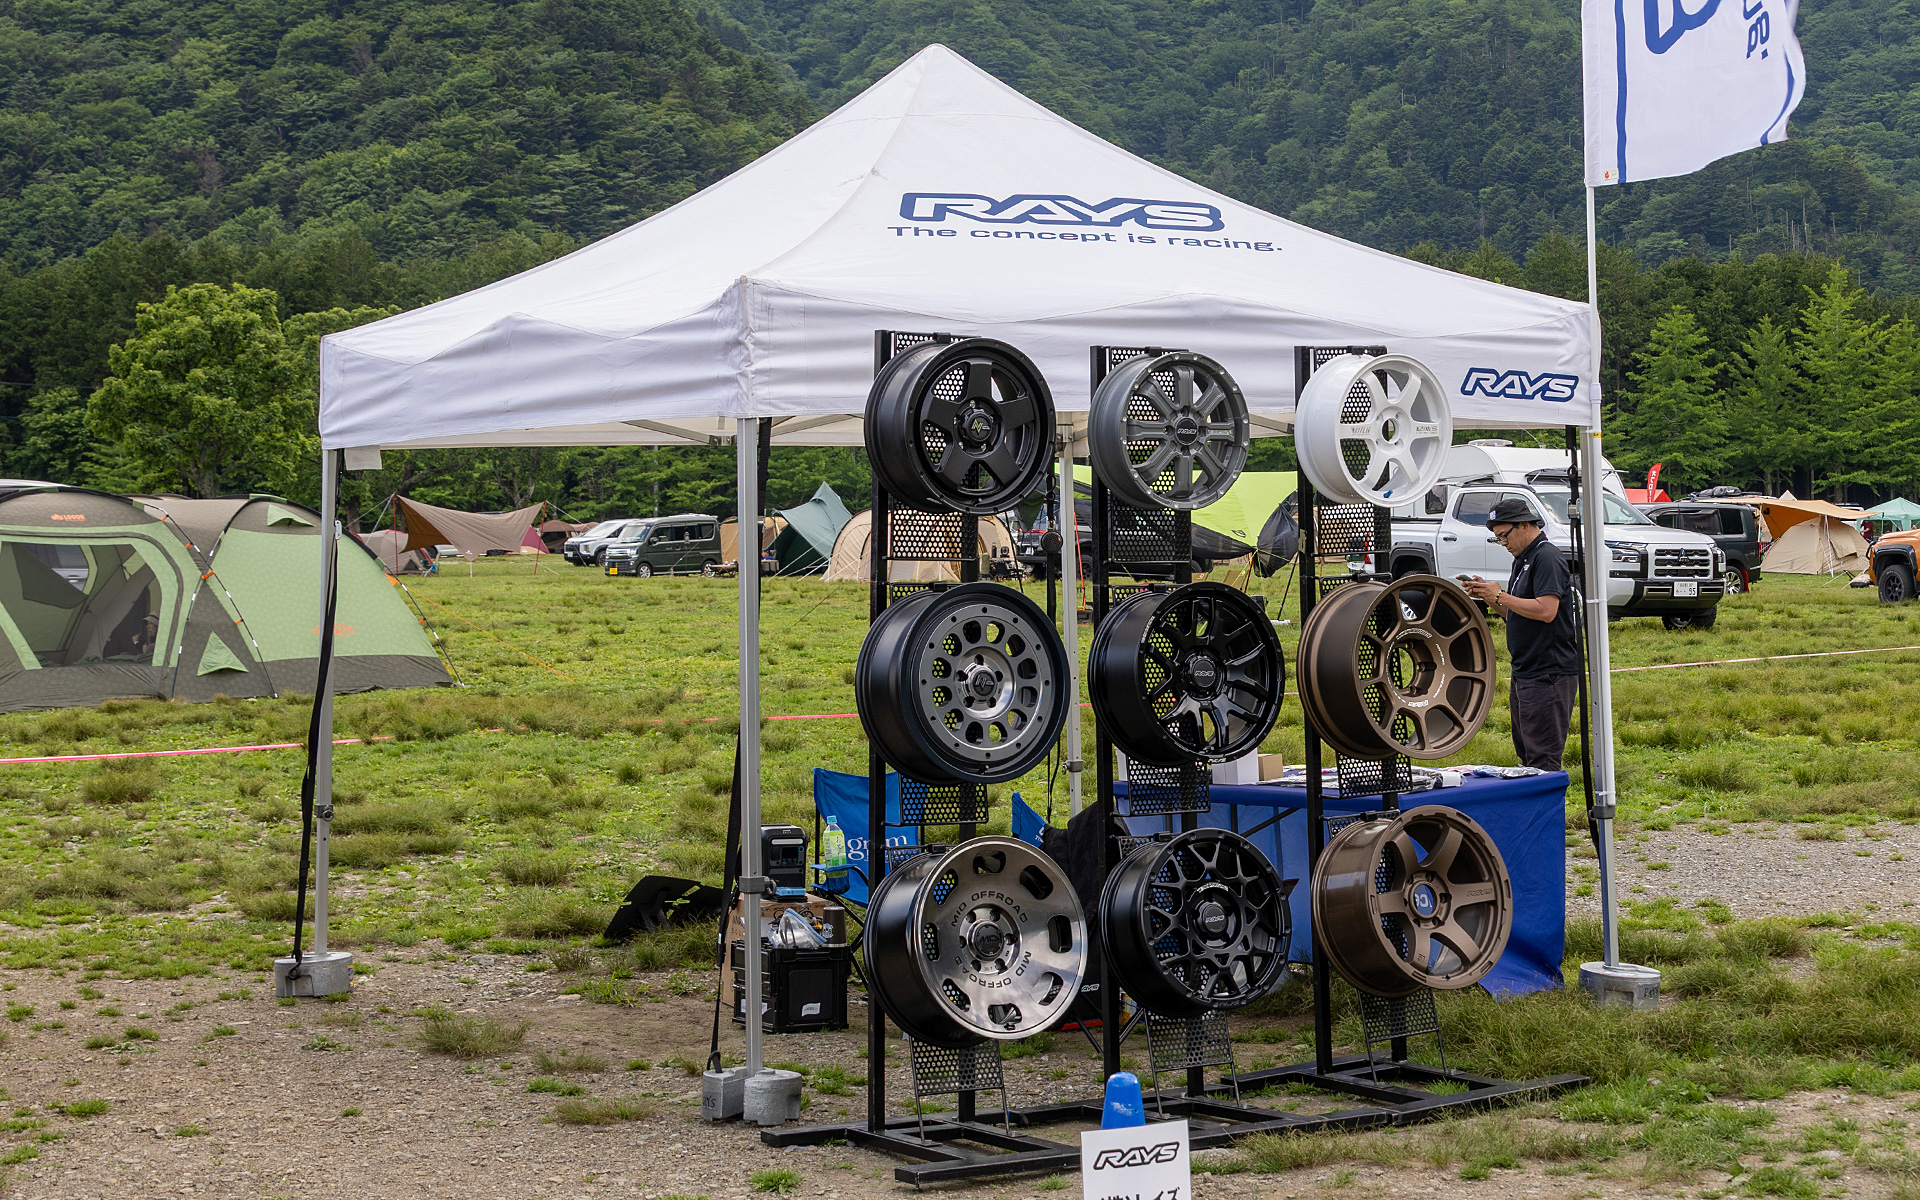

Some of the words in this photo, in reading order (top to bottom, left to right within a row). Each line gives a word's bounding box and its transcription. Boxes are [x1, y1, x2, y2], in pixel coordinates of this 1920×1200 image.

[900, 193, 1225, 232] RAYS
[887, 226, 957, 238] The
[970, 228, 1117, 243] concept
[1128, 233, 1156, 244] is
[1167, 237, 1283, 252] racing.
[1461, 367, 1579, 402] RAYS
[951, 902, 967, 927] MID
[971, 891, 1028, 923] OFFROAD
[955, 956, 1012, 989] OFFROAD
[1015, 951, 1031, 976] MID
[1093, 1141, 1180, 1171] RAYS
